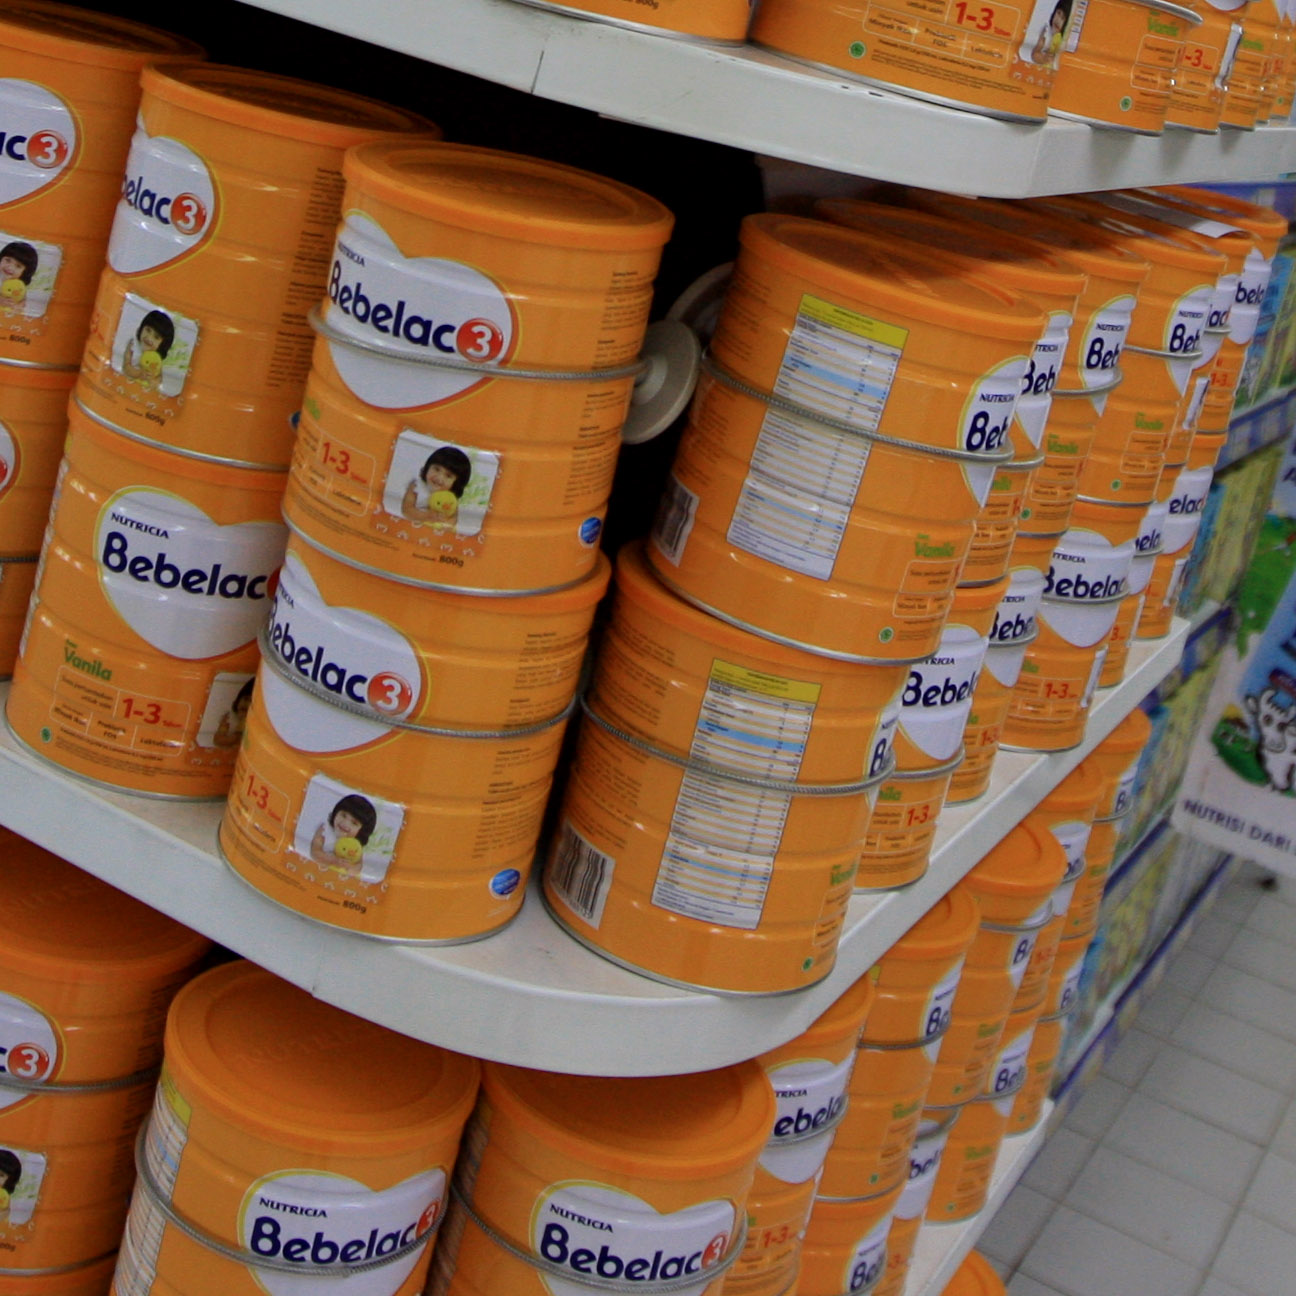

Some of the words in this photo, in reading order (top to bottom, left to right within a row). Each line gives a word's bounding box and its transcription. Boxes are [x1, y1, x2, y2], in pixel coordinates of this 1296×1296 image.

[111, 512, 169, 540] NUTRICIA
[1184, 799, 1246, 833] NUTRISI
[1249, 825, 1291, 853] DARI
[258, 1197, 329, 1219] NUTRICIA
[550, 1203, 614, 1234] NUTRICIA
